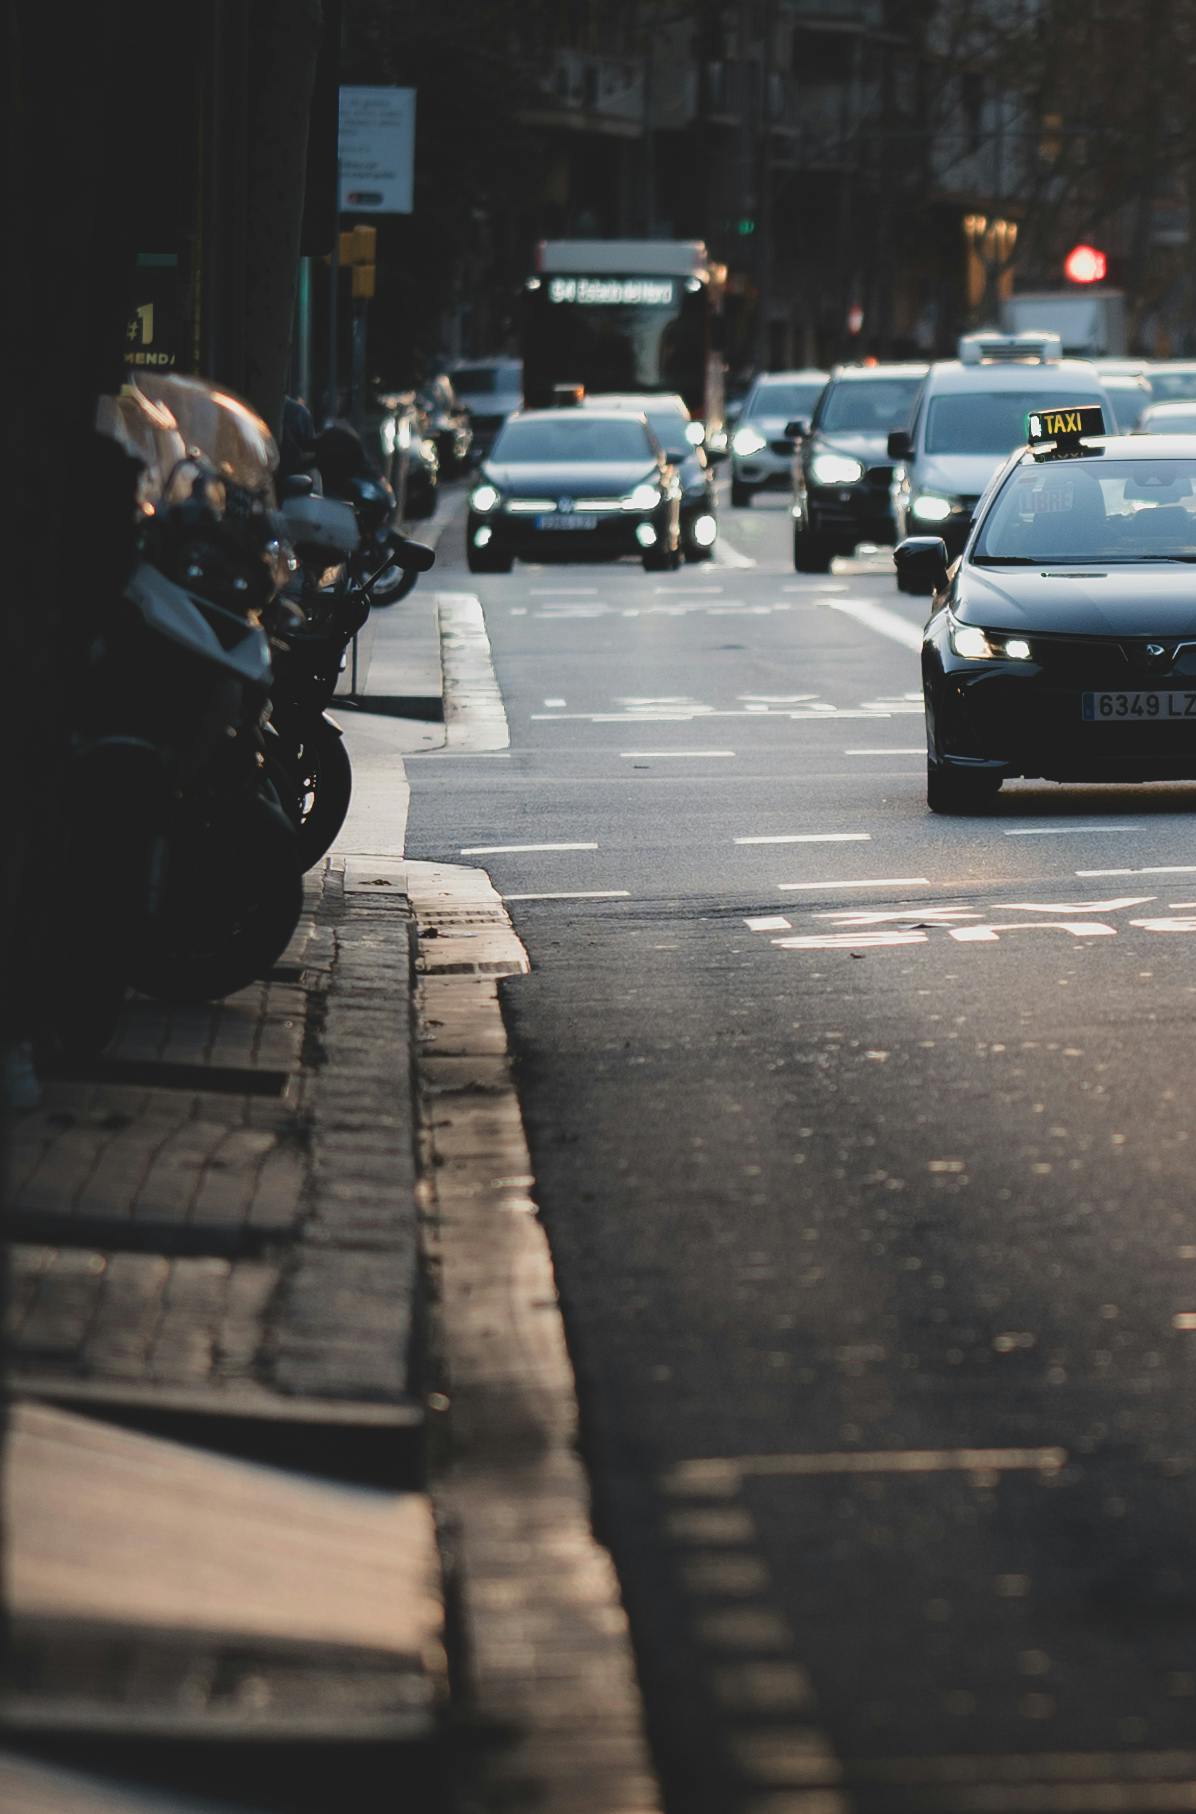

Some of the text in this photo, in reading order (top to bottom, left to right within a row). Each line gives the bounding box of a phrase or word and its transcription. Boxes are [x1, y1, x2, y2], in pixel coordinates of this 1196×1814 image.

[127, 303, 153, 344] #1
[1044, 412, 1082, 434] TAXI
[1100, 695, 1160, 717] 6349
